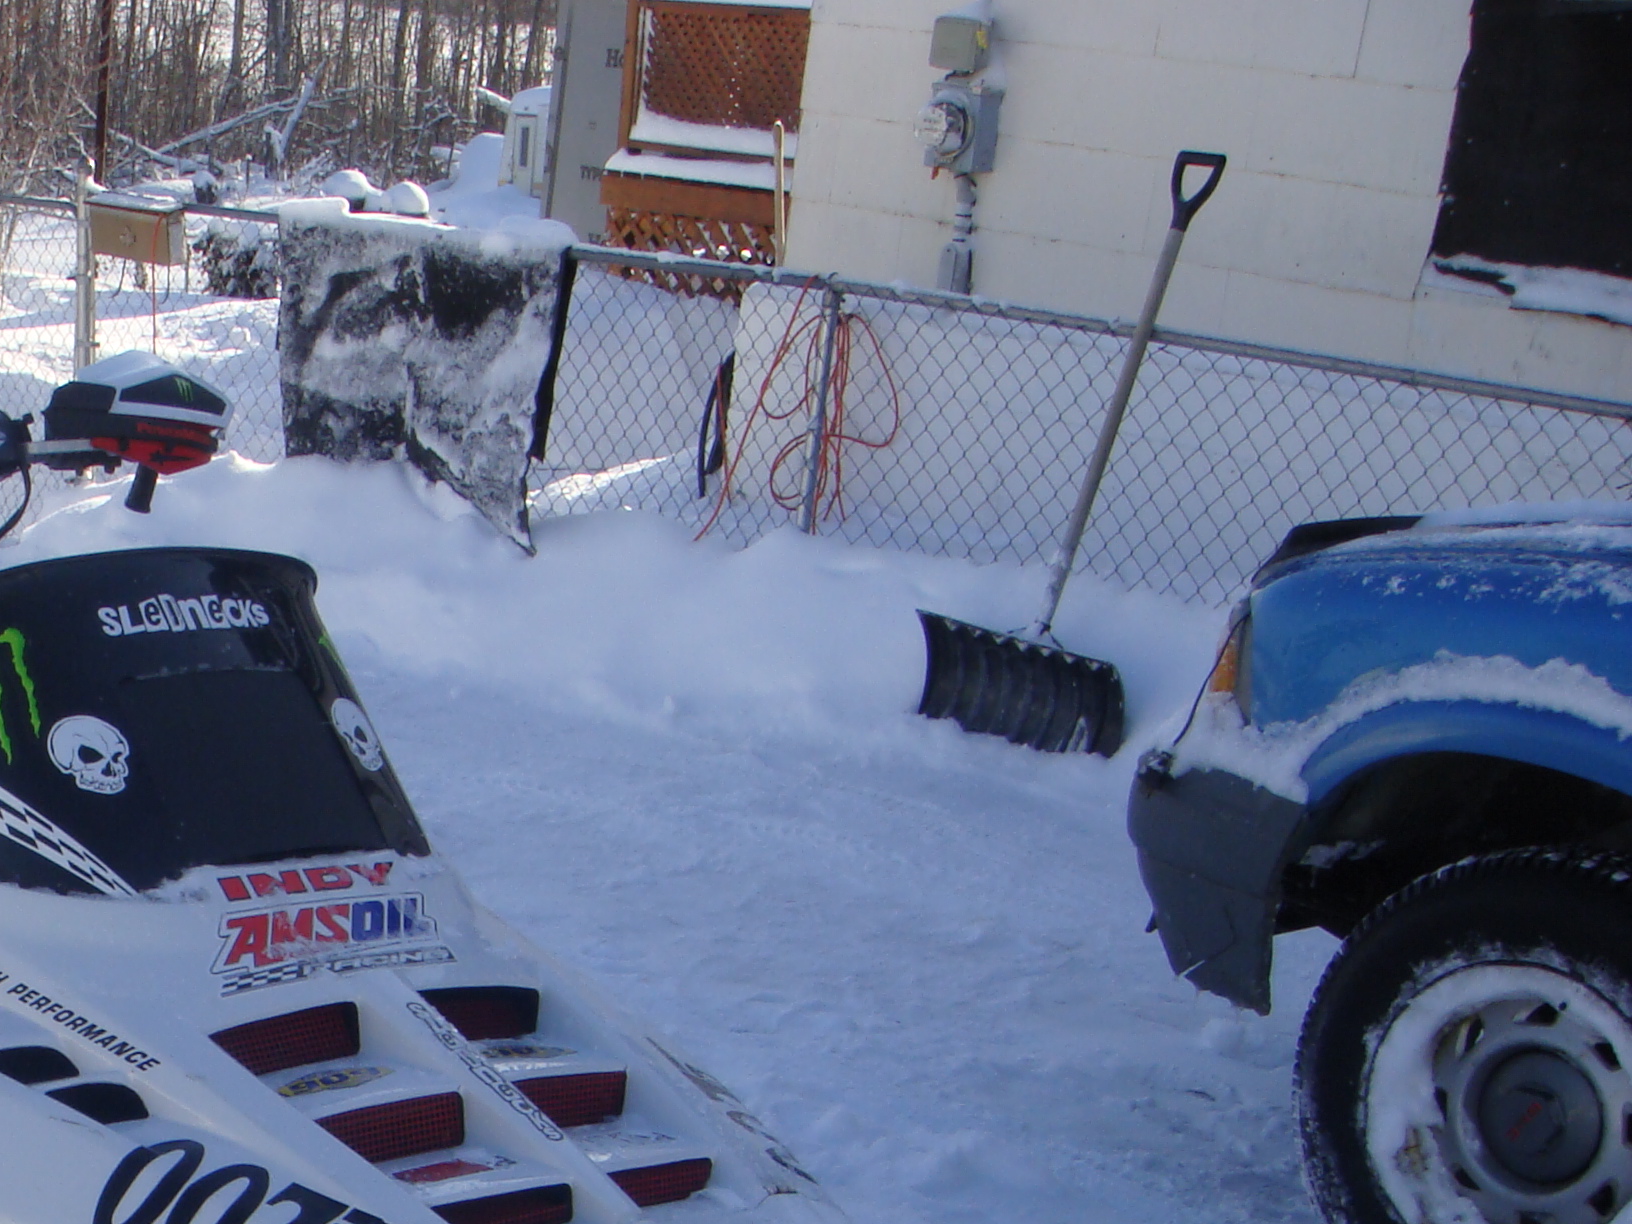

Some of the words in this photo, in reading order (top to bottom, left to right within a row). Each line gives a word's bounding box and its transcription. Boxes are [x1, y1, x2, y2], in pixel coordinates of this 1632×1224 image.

[217, 861, 394, 902] INDY
[223, 897, 432, 967] AMSOIL
[7, 982, 161, 1072] PERFORMANCE
